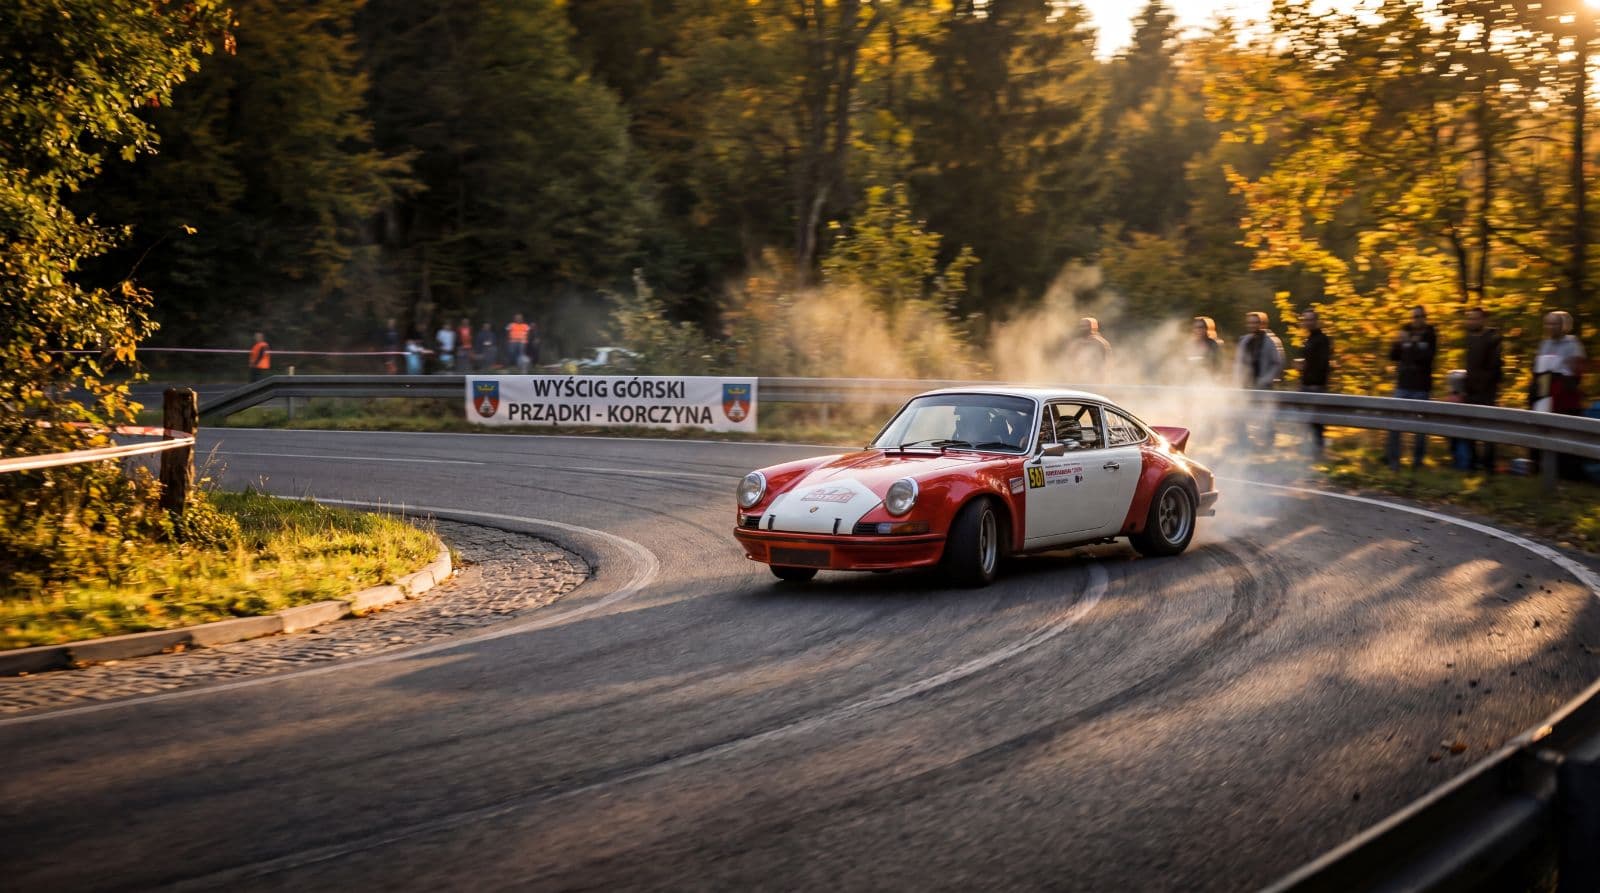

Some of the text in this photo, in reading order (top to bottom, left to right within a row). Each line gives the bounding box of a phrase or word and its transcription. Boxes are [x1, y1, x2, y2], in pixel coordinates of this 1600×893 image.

[533, 376, 685, 399] WYŚCIG GÓRSKI
[508, 403, 591, 426] PRZĄDKI
[608, 405, 713, 424] KORCZYNA
